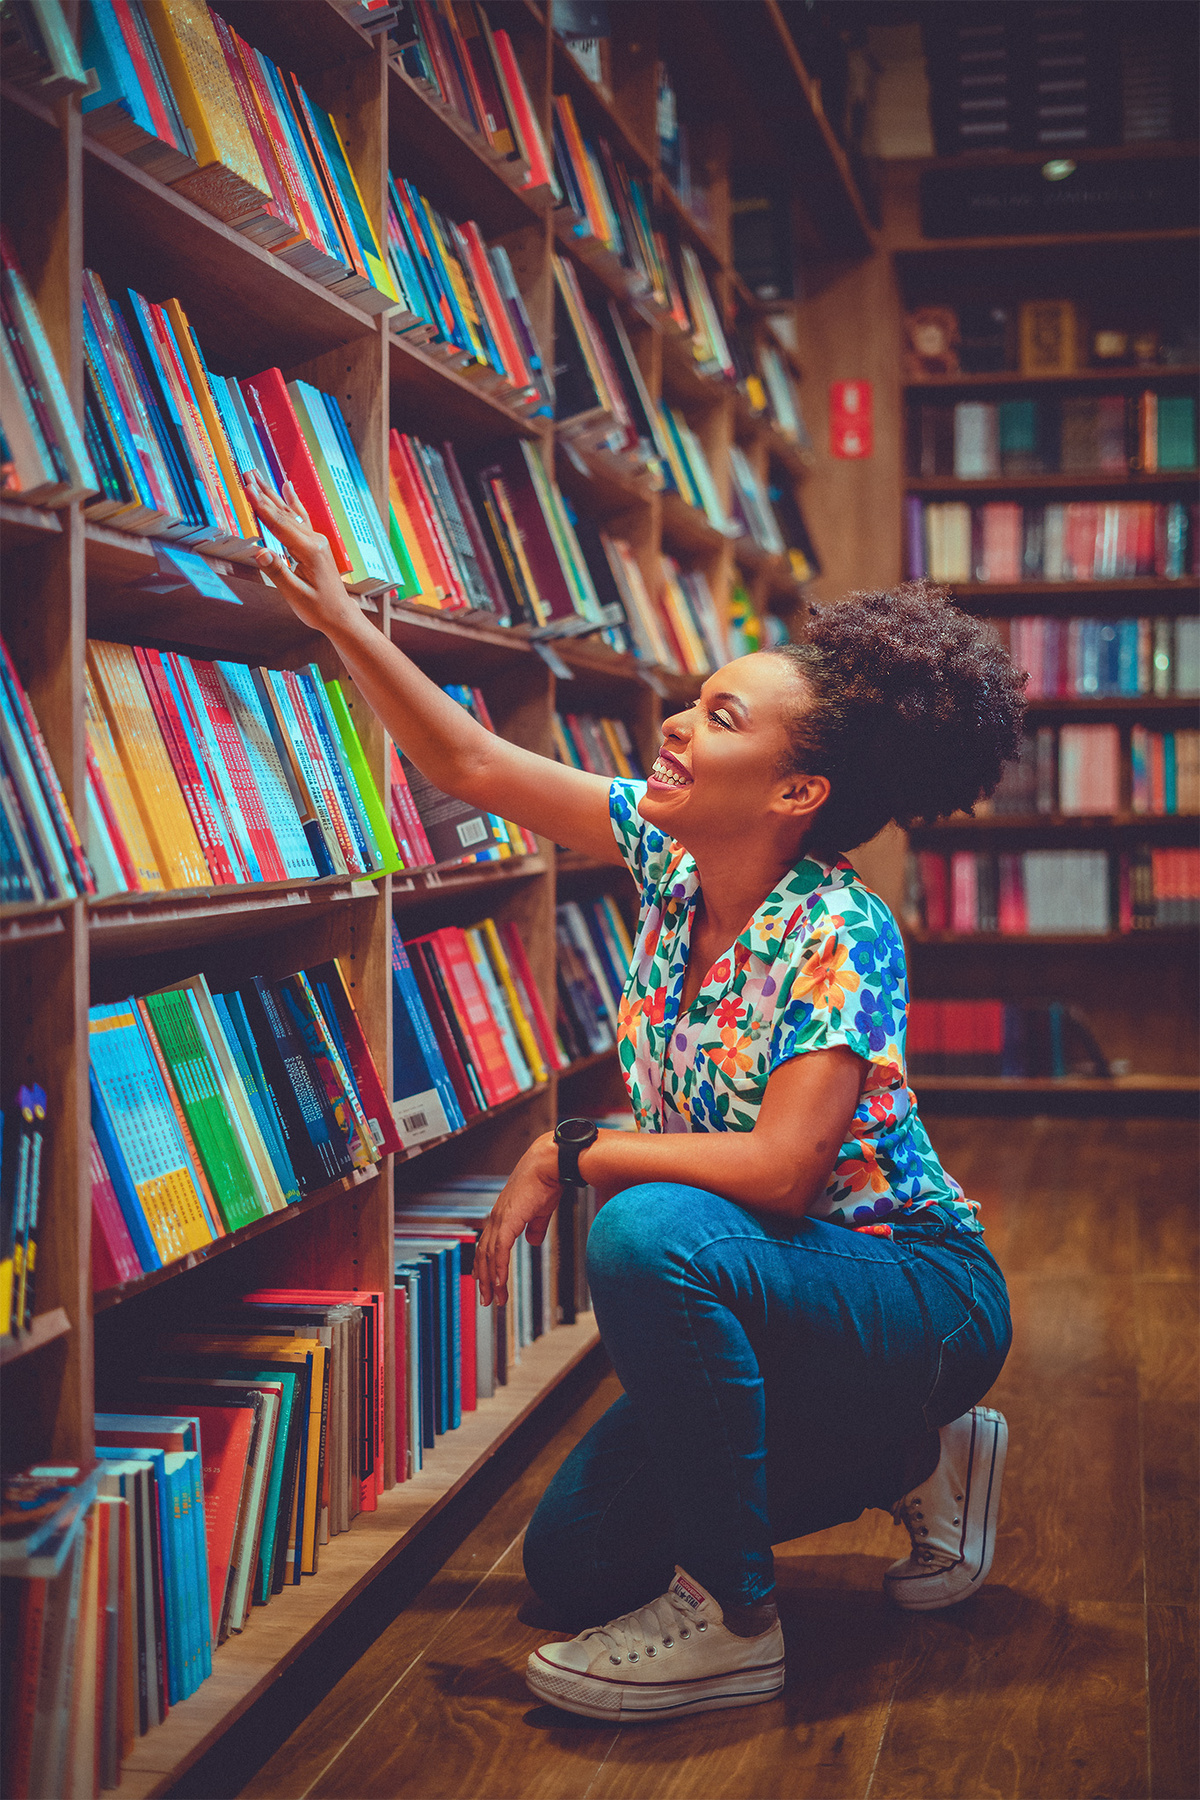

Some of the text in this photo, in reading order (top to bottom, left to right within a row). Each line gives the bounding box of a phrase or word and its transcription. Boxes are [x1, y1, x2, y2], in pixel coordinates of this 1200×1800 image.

[212, 1466, 221, 1474] 25
[680, 1579, 702, 1600] CONVERSE
[686, 1594, 699, 1609] STAR
